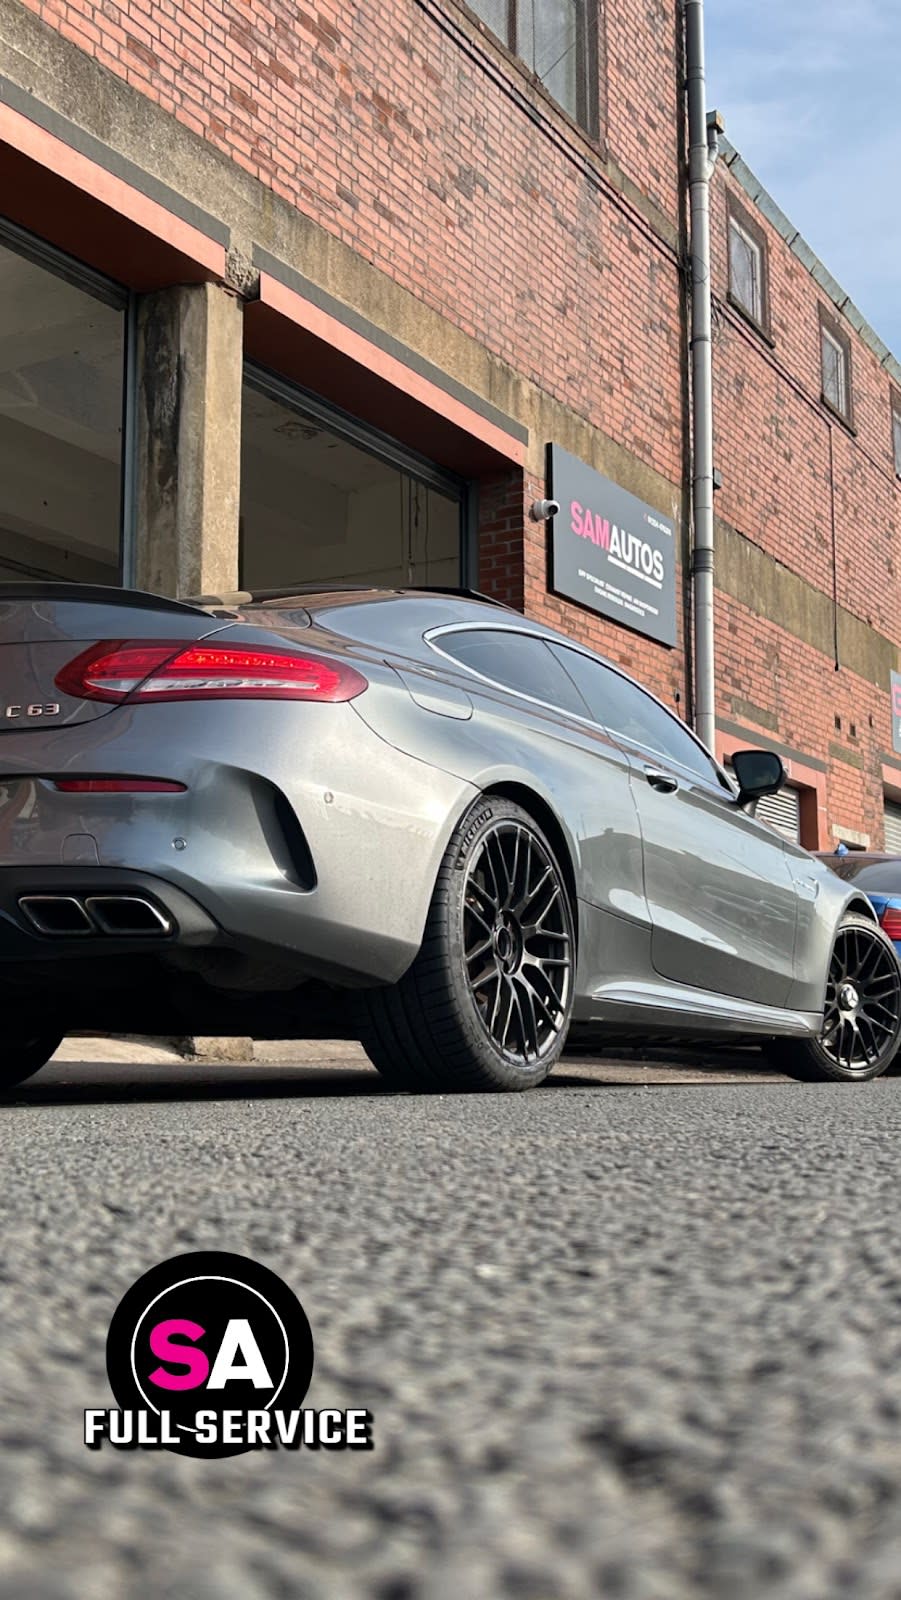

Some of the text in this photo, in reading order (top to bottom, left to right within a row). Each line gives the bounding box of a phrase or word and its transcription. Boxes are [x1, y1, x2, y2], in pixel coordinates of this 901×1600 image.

[570, 500, 664, 581] SAMAUTOS
[6, 703, 60, 718] C 63
[460, 808, 493, 856] MICHELIN
